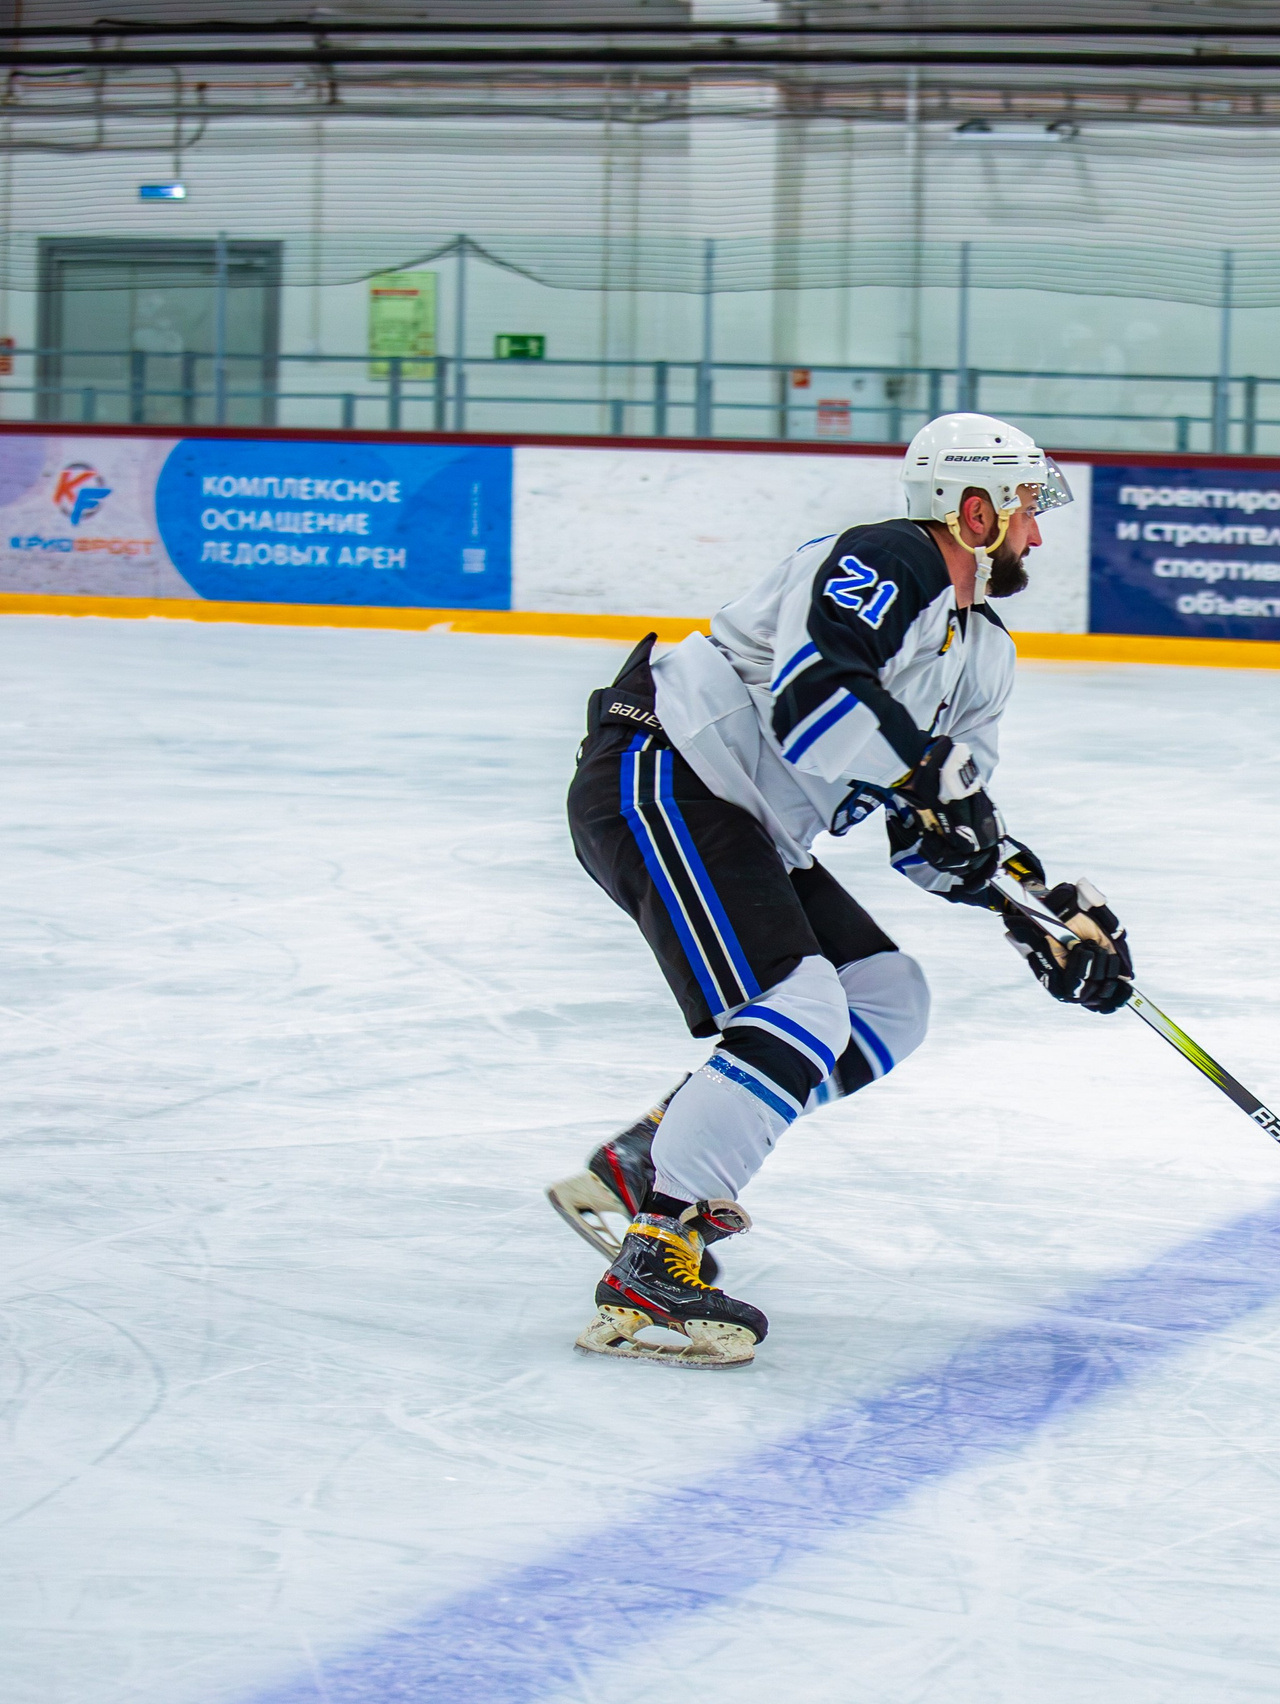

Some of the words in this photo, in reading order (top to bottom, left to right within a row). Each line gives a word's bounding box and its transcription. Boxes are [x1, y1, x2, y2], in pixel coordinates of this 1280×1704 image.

[944, 455, 990, 463] BAUER
[202, 475, 401, 503] КОМПЛЕКСНОЕ
[201, 508, 370, 536] ОСНАЩЕНИЕ
[1116, 521, 1140, 541] и
[200, 541, 331, 568] ЛЕДОВЫХ
[337, 546, 407, 569] АРЕН
[823, 555, 899, 630] 21
